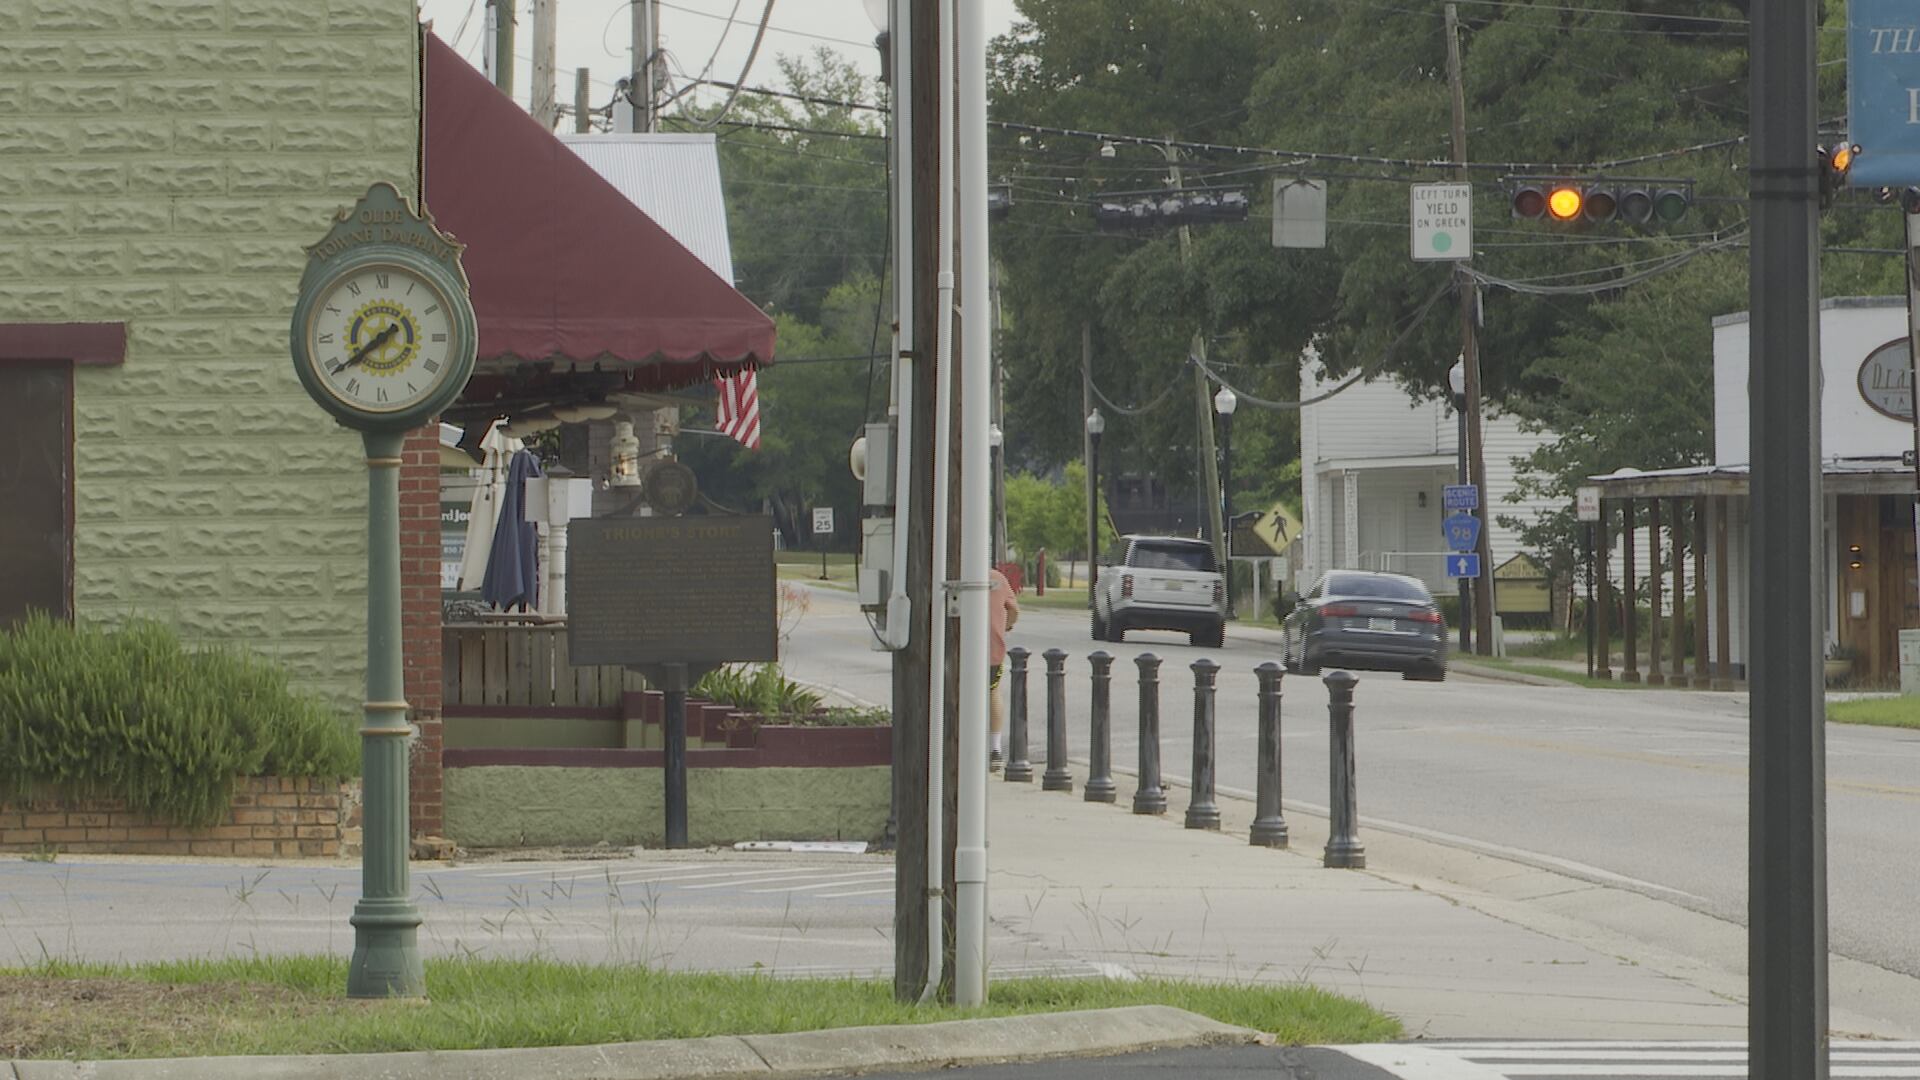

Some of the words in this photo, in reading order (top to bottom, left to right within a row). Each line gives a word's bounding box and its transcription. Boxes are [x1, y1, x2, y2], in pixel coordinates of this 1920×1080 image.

[1871, 28, 1920, 54] TH
[1415, 190, 1438, 200] LEFT
[1443, 189, 1468, 199] TURN
[1426, 203, 1458, 215] YIELD
[360, 209, 404, 224] OLDE
[1416, 218, 1430, 229] ON
[1435, 217, 1467, 229] GREEN
[315, 227, 374, 261] TOWNE
[382, 226, 451, 261] DAPHNE
[1446, 487, 1477, 498] SCENIC
[1447, 497, 1476, 507] ROUTE
[815, 520, 832, 531] 25
[1451, 526, 1472, 541] 98
